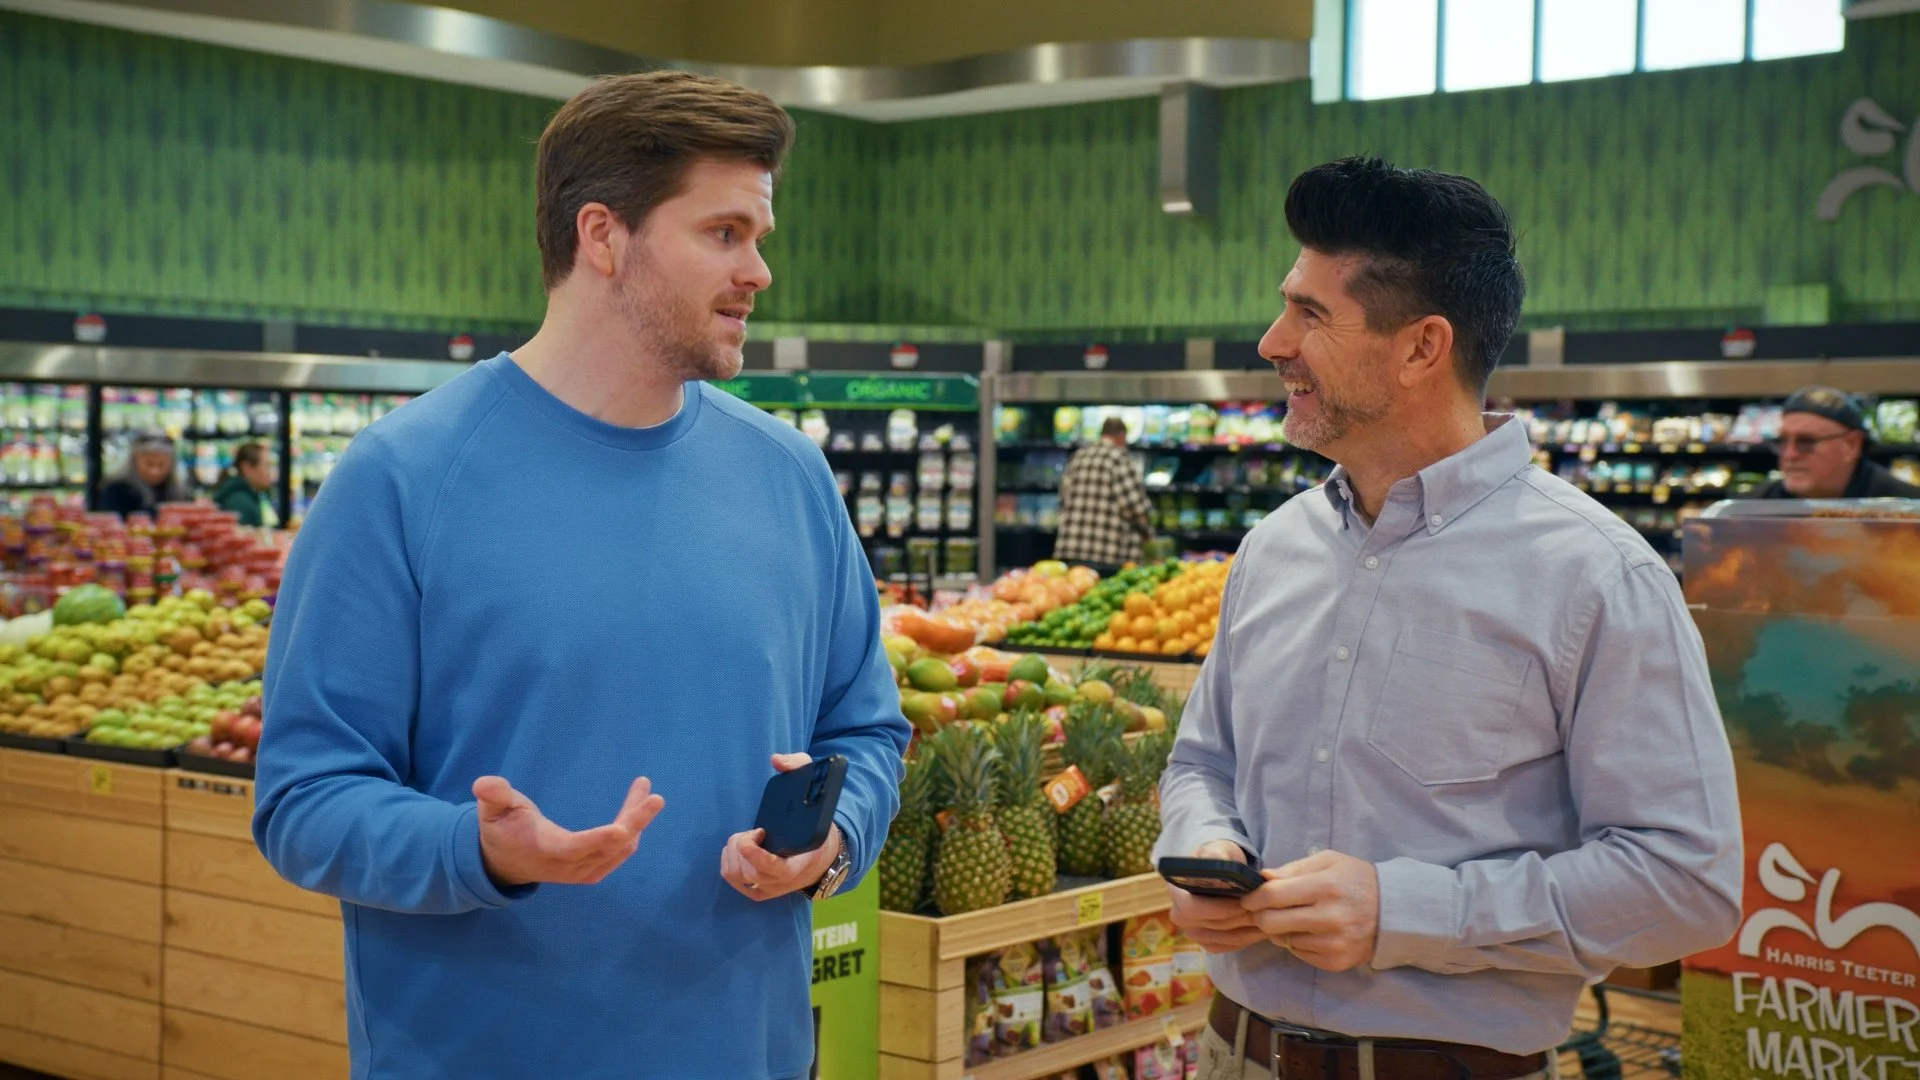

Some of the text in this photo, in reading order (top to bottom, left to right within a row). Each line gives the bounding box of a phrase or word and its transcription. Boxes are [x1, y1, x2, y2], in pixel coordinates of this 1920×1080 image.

[846, 380, 931, 400] ORGANIC
[812, 921, 858, 951] TEIN
[1766, 947, 1916, 988] HARRIS TEETER
